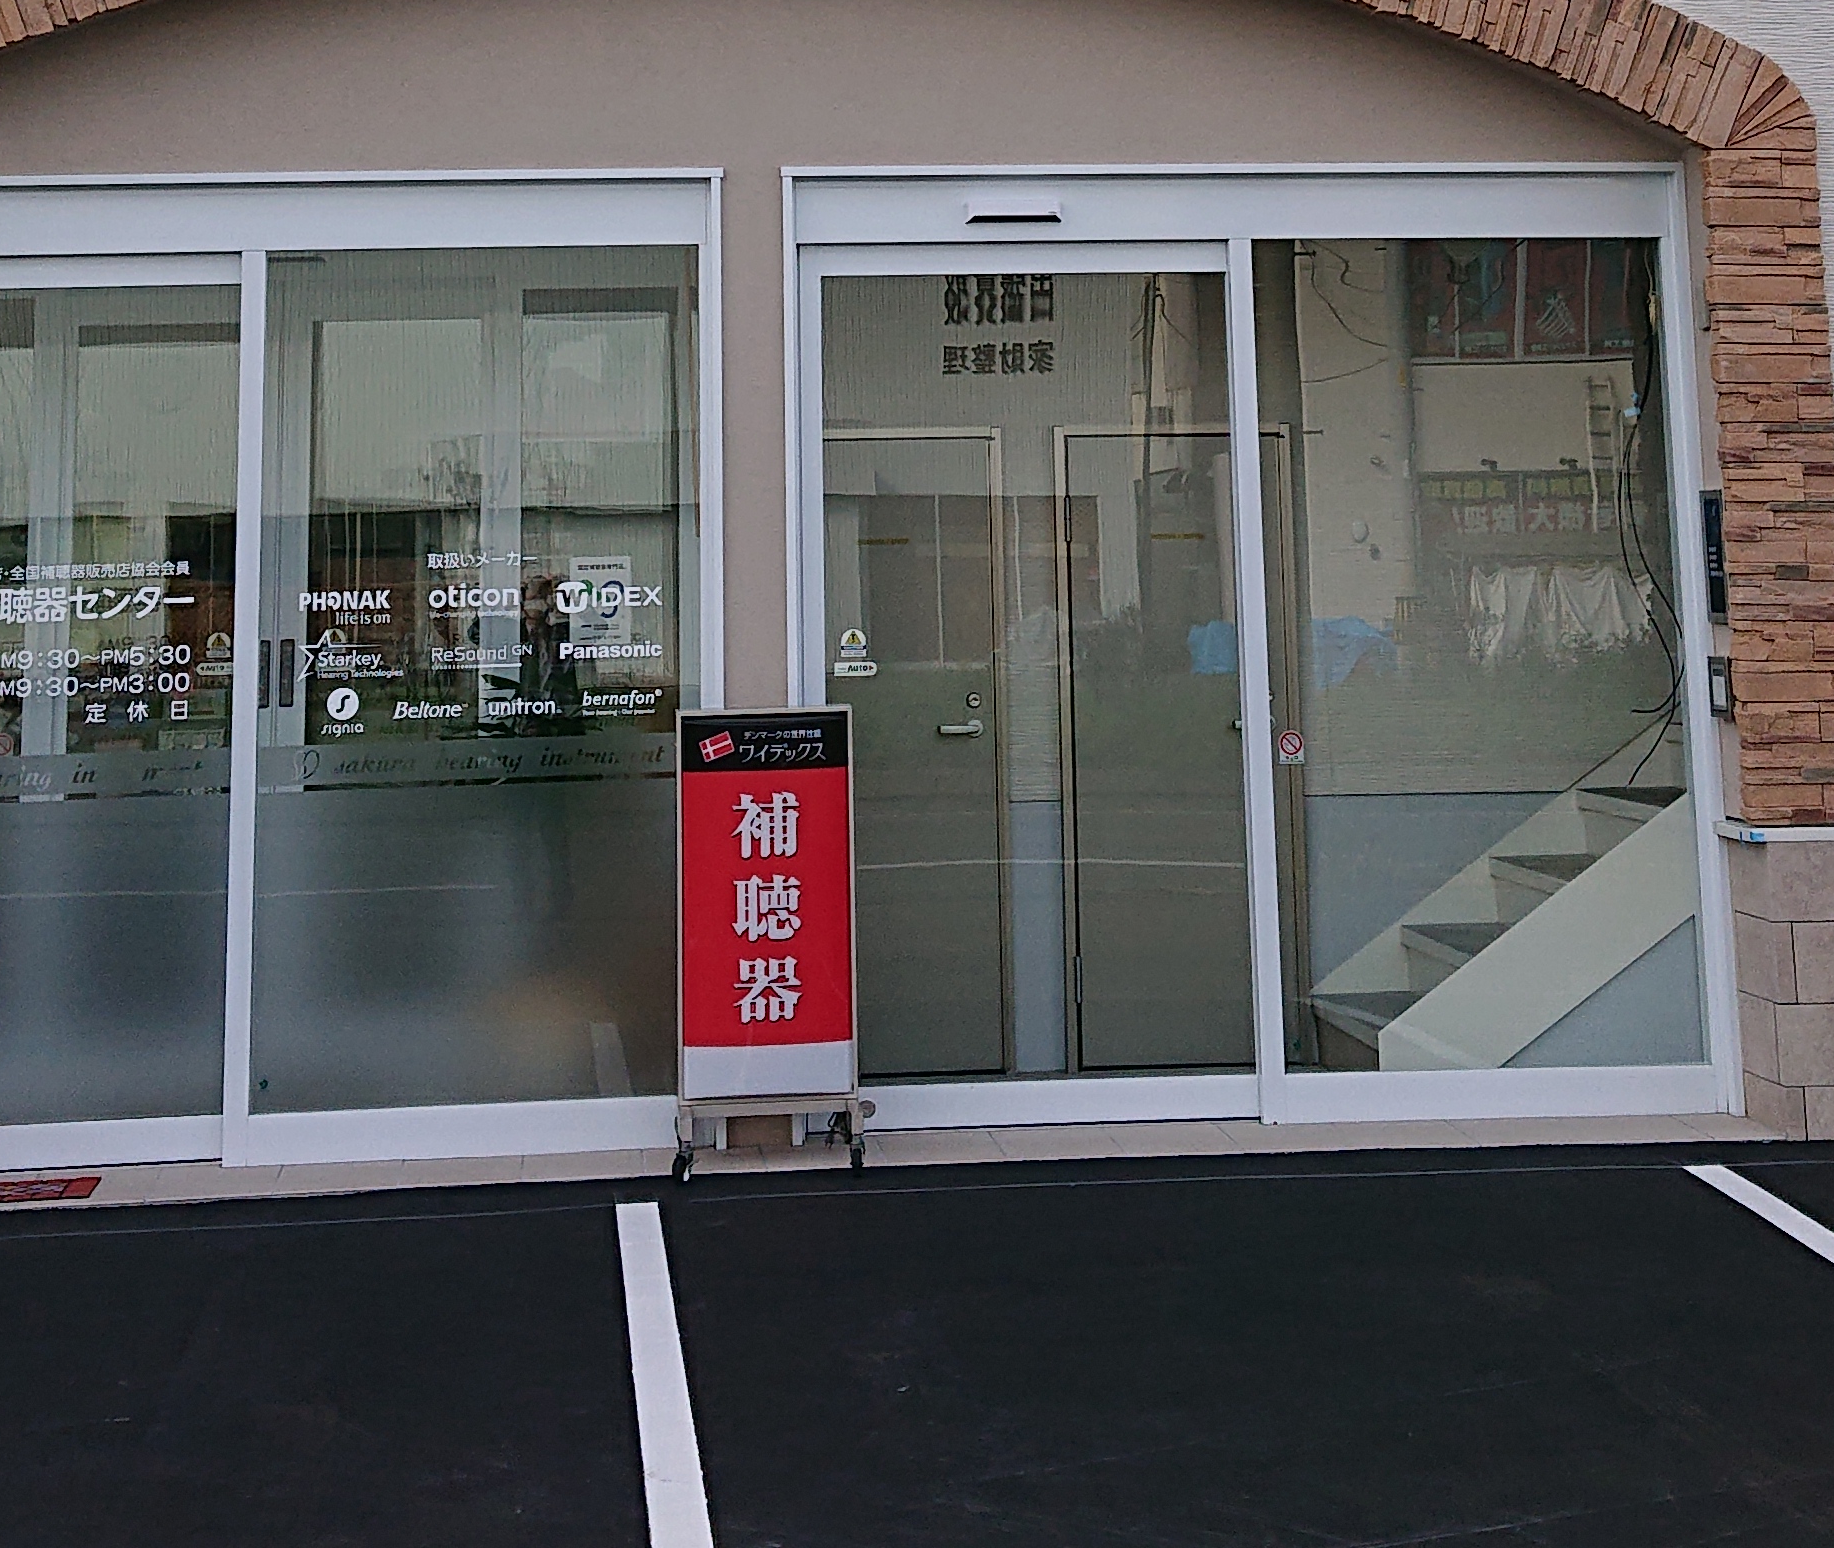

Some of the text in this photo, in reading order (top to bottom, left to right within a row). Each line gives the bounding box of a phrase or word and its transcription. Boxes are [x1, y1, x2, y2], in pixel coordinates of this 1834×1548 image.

[426, 550, 538, 570] 取扱いメーカー
[298, 589, 392, 612] PHONAK
[428, 583, 521, 609] oticon
[555, 581, 663, 614] WIDEX
[335, 611, 391, 626] life is on
[430, 644, 533, 663] ReSound GN
[559, 640, 663, 660] Panasonic
[392, 700, 463, 720] Beltone
[320, 722, 365, 738] signia
[738, 742, 827, 764] ワイデックス
[730, 790, 804, 1025] 補聴器
